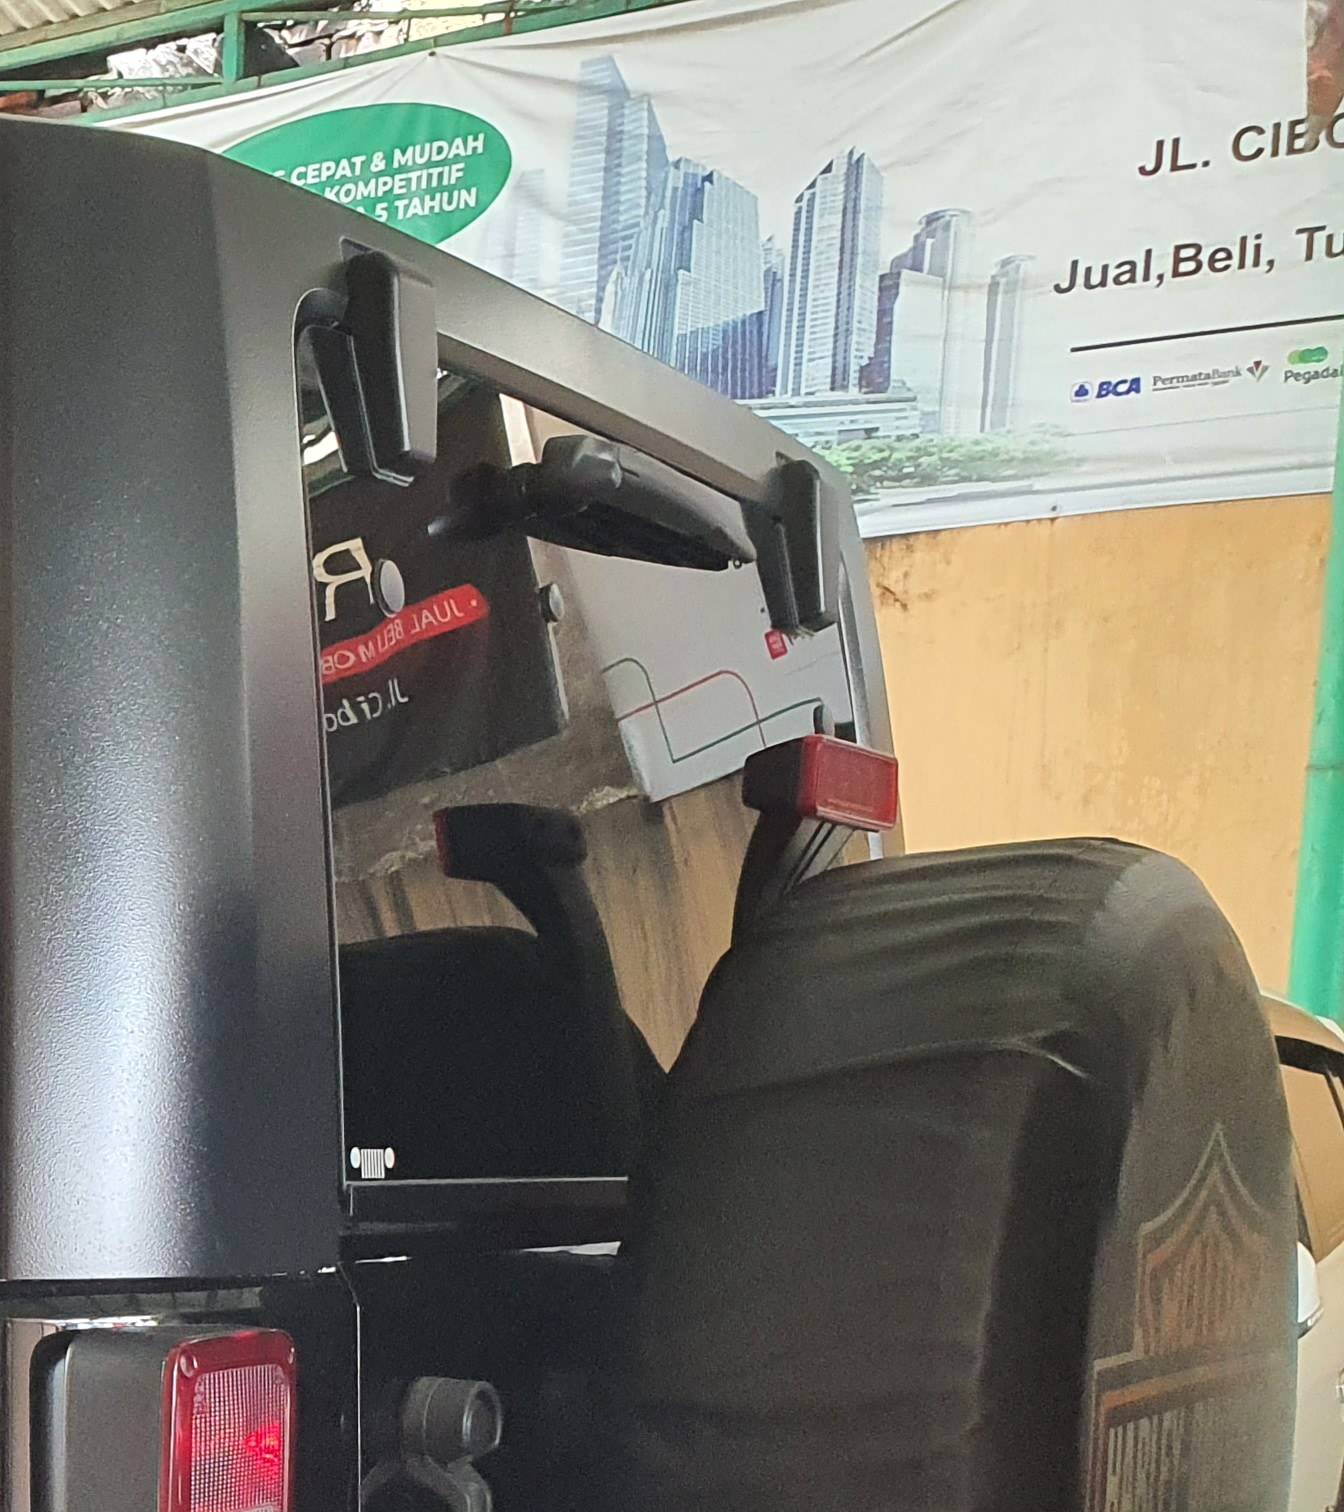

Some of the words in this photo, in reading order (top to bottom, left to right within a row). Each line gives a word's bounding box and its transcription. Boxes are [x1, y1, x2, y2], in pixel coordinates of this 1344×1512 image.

[290, 154, 367, 187] CEPAT
[370, 151, 387, 173] &
[393, 132, 486, 170] MUDAH
[1138, 136, 1211, 176] JL.
[323, 162, 466, 204] KOMPETITIF
[395, 187, 478, 221] TAHUN
[1095, 376, 1141, 399] BCA
[1152, 365, 1243, 387] PermataBank
